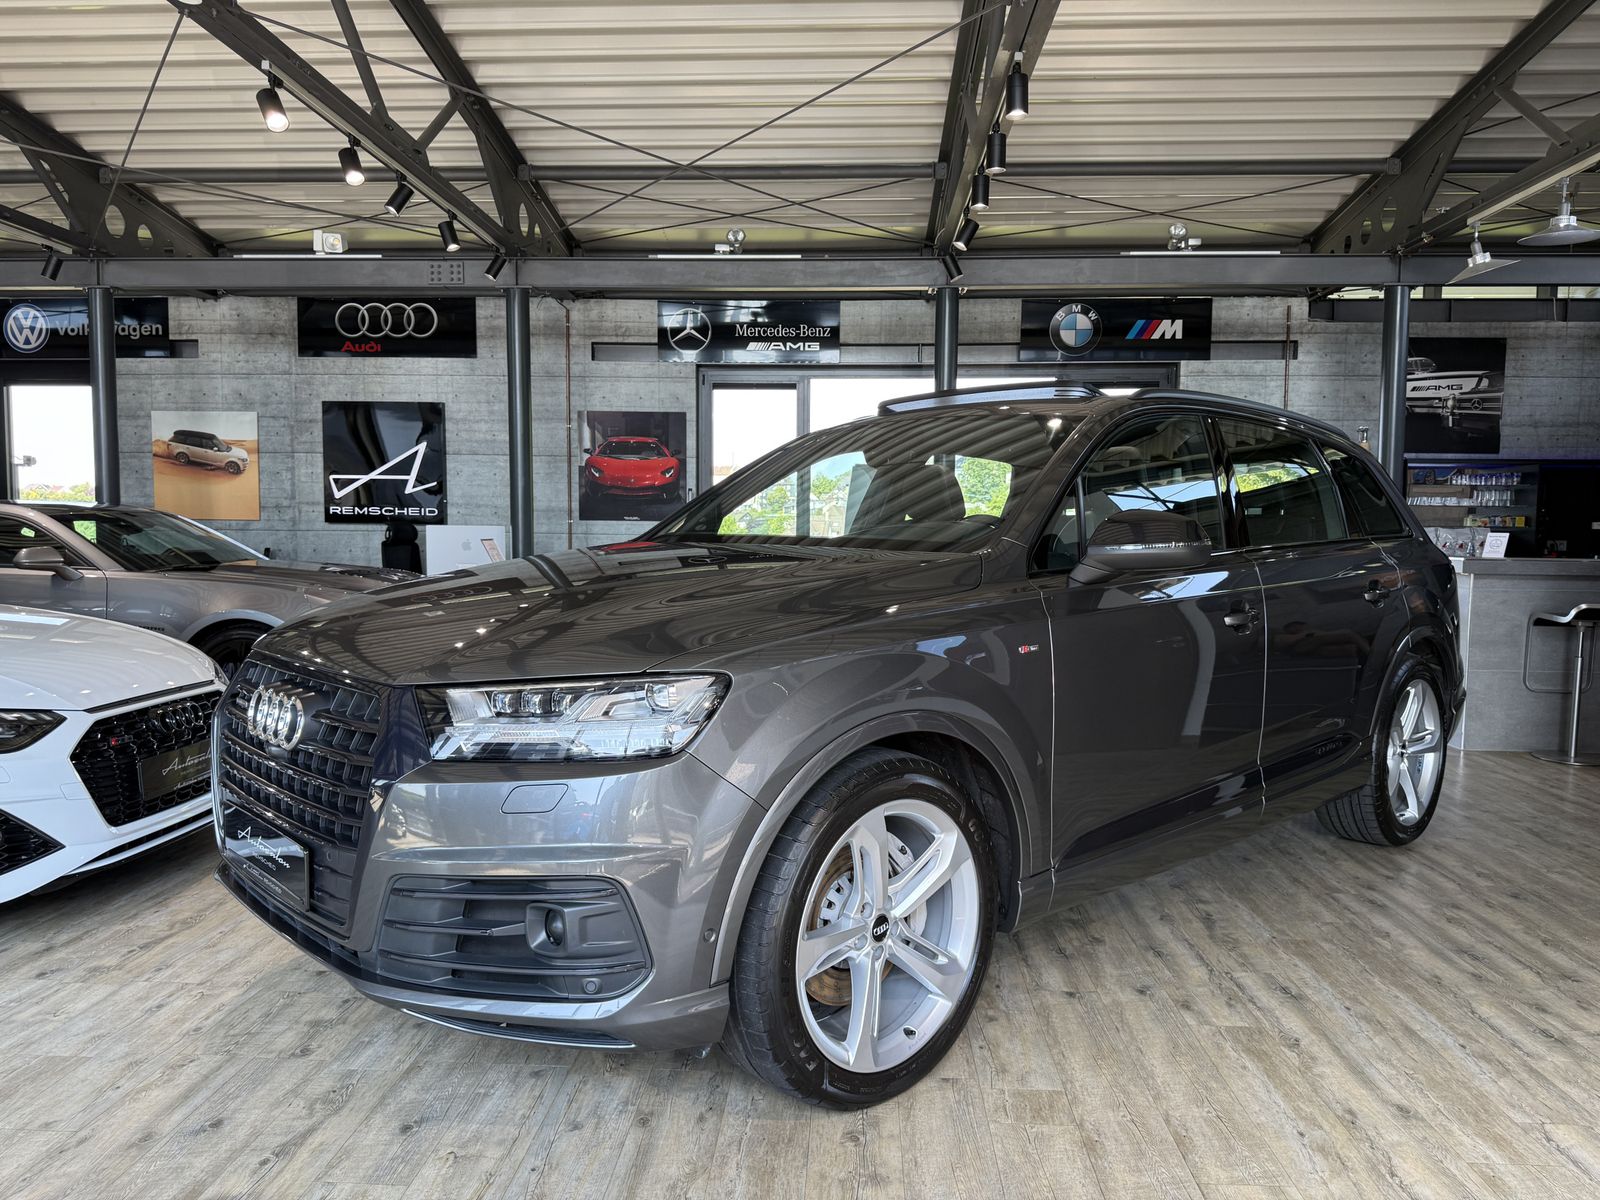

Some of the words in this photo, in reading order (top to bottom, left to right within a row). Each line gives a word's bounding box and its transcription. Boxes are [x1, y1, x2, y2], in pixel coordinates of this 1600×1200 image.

[1055, 304, 1099, 321] BMW
[55, 320, 163, 340] Volkagen
[734, 323, 831, 337] Mercedes-Benz
[341, 341, 382, 352] Audi
[767, 341, 820, 351] AMG
[1425, 383, 1463, 392] AMG
[329, 506, 439, 516] REMSCHEID
